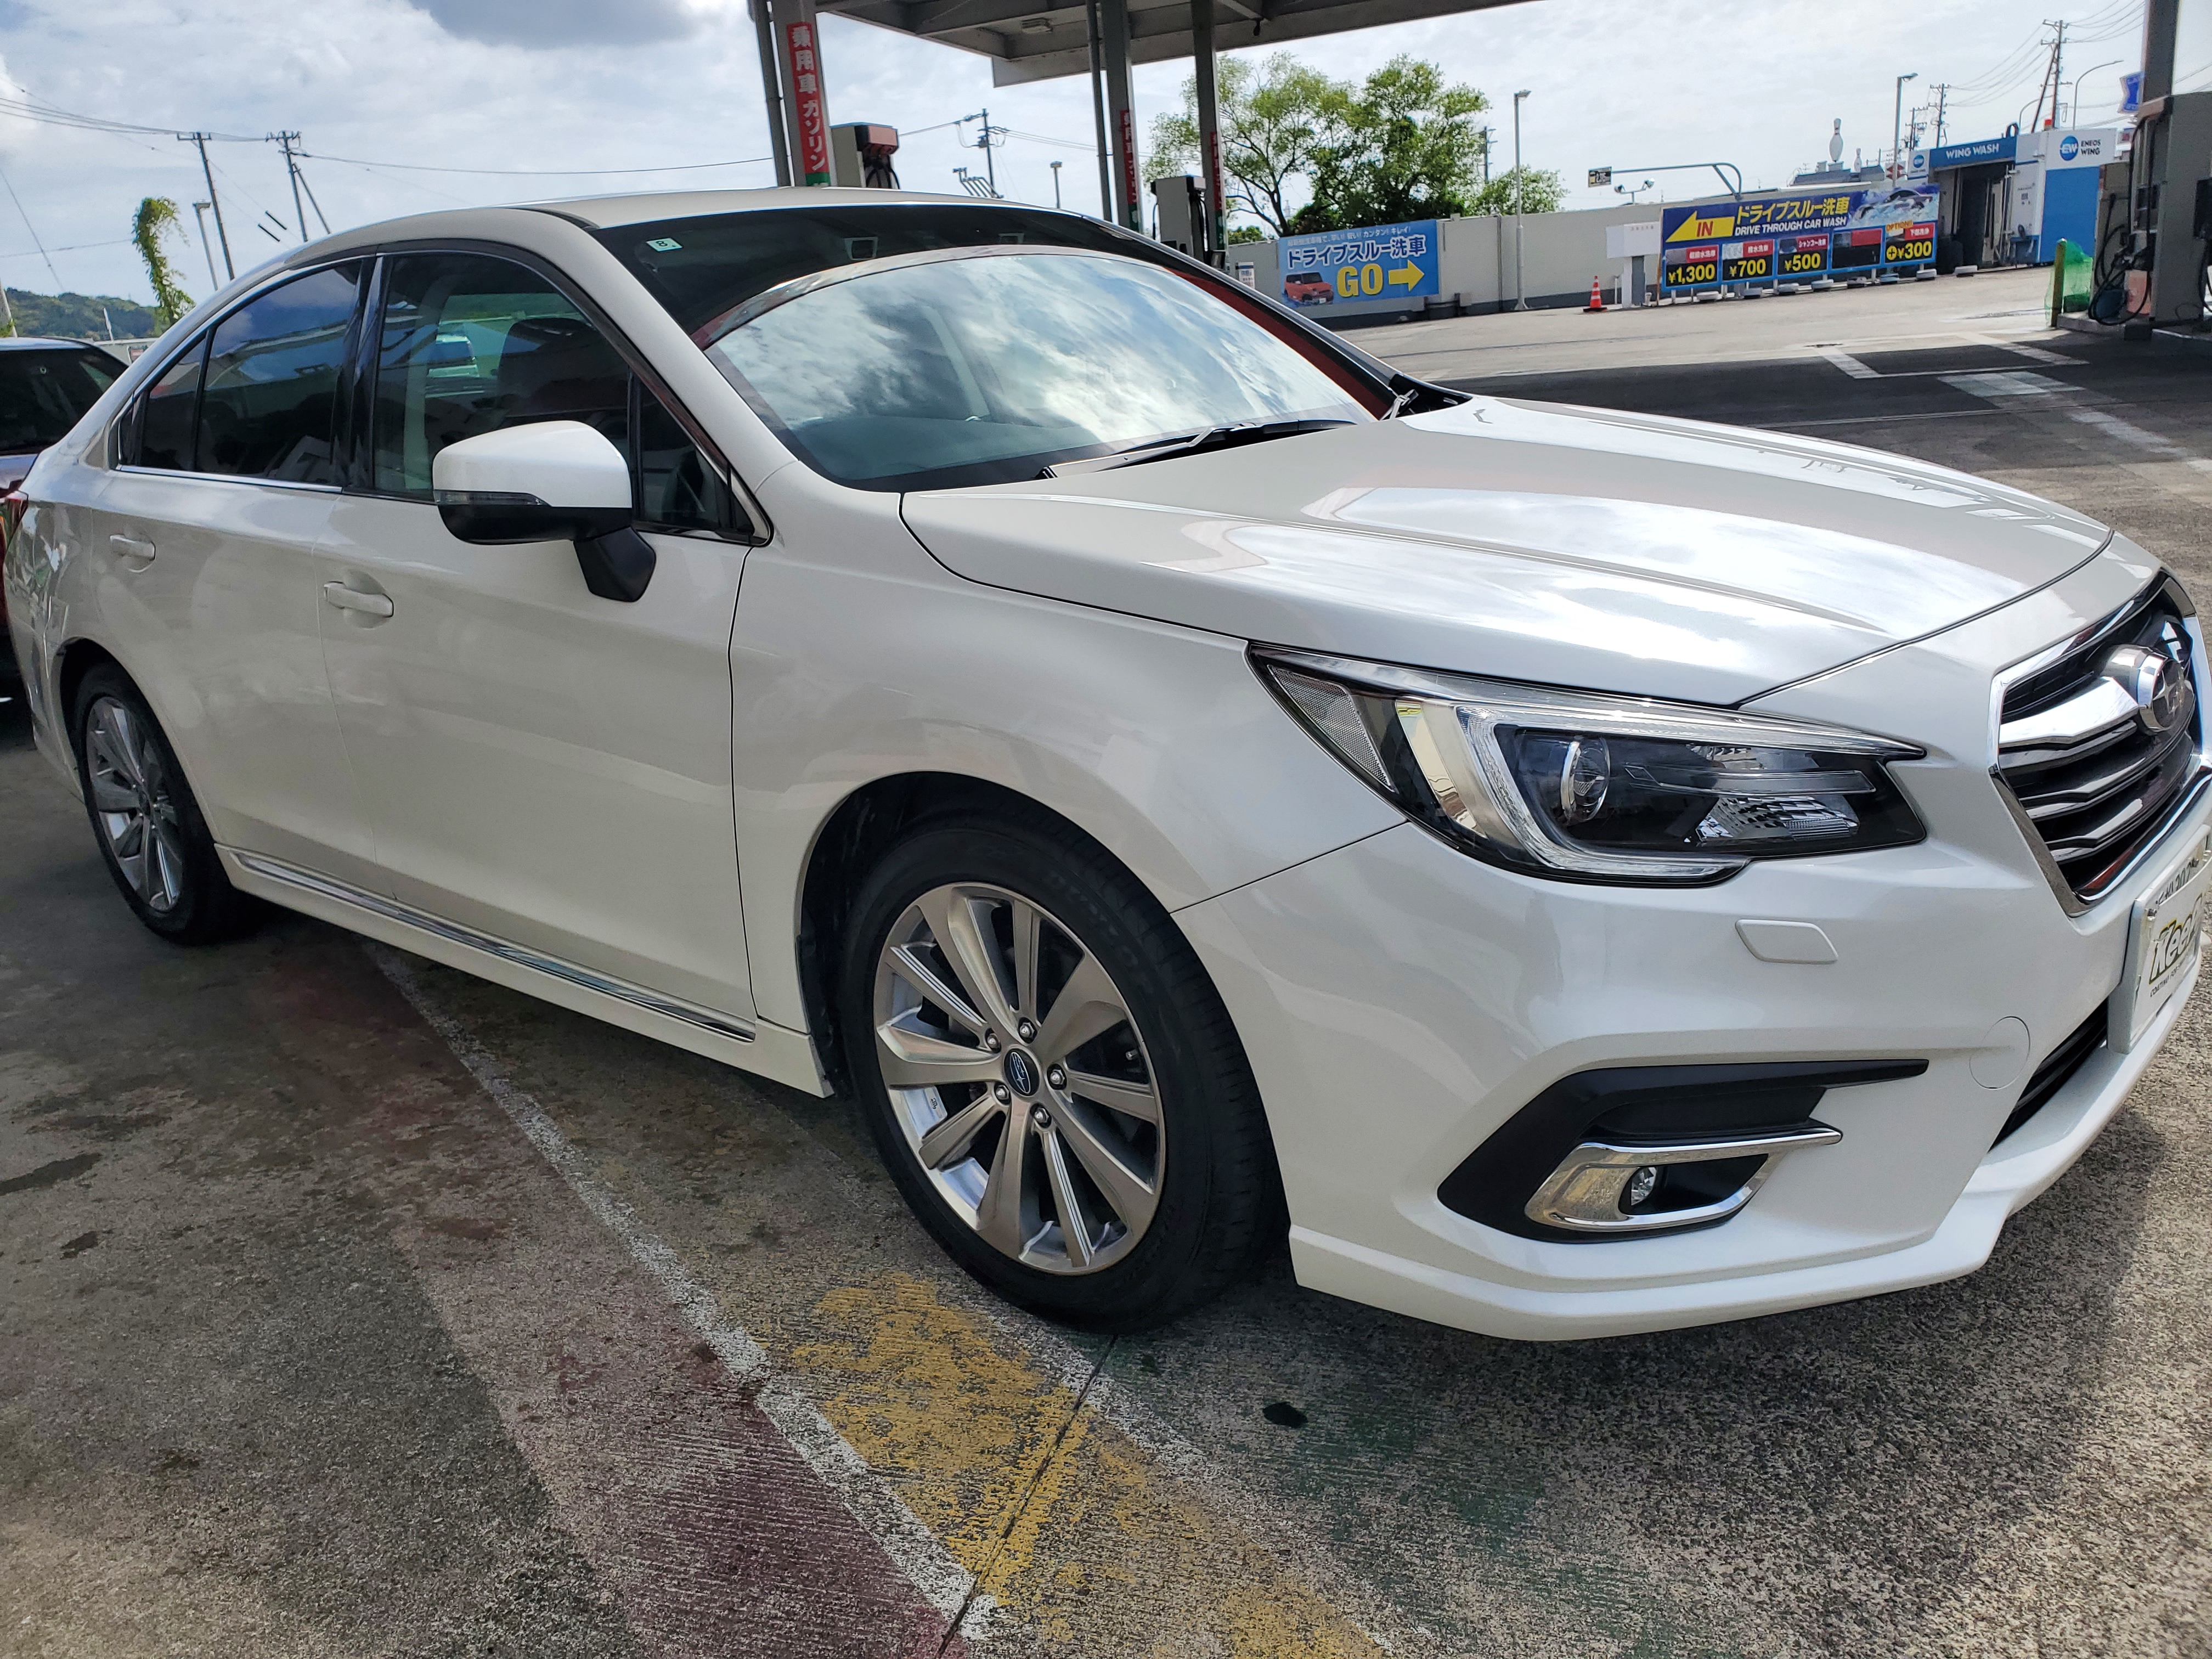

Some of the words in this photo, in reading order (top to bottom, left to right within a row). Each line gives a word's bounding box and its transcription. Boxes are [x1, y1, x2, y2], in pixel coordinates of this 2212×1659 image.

[1945, 147, 1971, 159] WING
[1973, 143, 2000, 155] WASH
[2081, 147, 2101, 155] WING
[1737, 197, 1850, 224] ドライブスルー洗車
[1696, 221, 1713, 238] IN
[1735, 224, 1760, 236] DRIVE
[1763, 220, 1803, 233] THROUGH
[1804, 218, 1821, 229] CAR
[1822, 216, 1847, 227] WASH
[1288, 234, 1426, 269] ドライブスルー洗車
[1730, 259, 1766, 277] ¥700
[1785, 253, 1821, 272] ¥500
[1337, 263, 1383, 297] GO
[1668, 263, 1716, 284] ¥1,300
